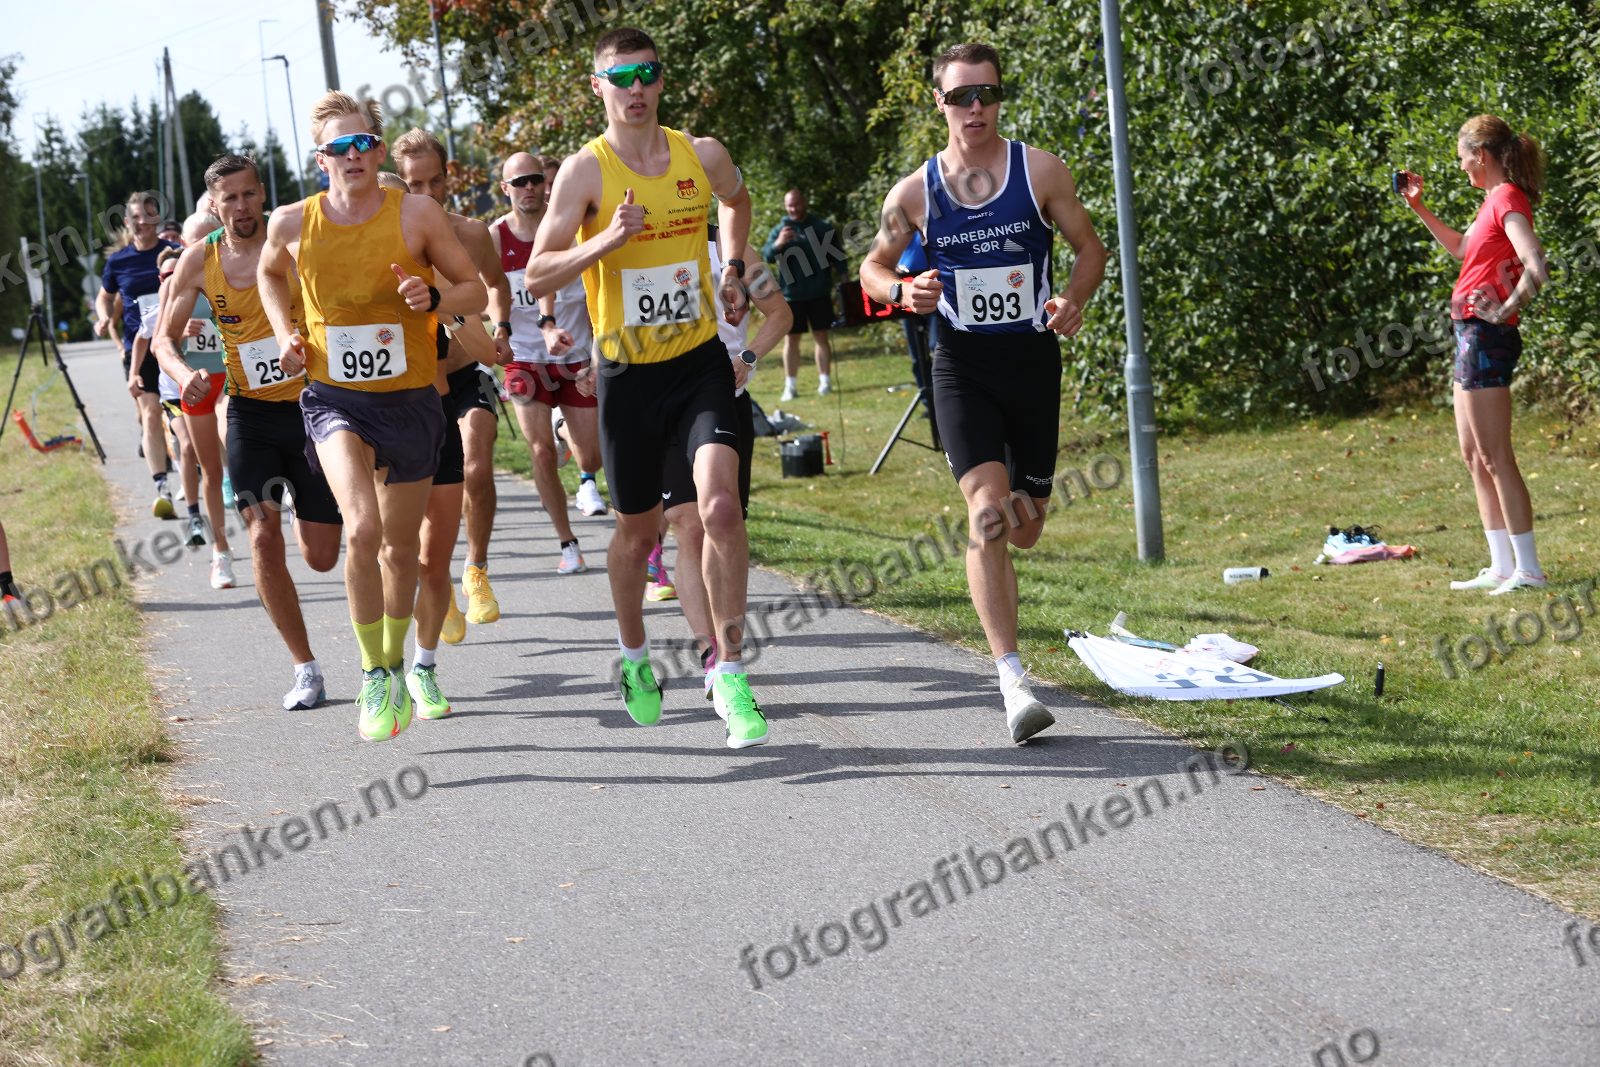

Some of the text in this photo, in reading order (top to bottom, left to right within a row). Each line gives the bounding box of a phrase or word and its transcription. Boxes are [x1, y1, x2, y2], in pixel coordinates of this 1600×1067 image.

[936, 220, 1031, 248] SPAREBANKEN
[972, 240, 1000, 254] SØR
[638, 290, 690, 323] 942
[972, 292, 1021, 322] 993
[255, 357, 292, 385] 25
[342, 348, 392, 379] 992
